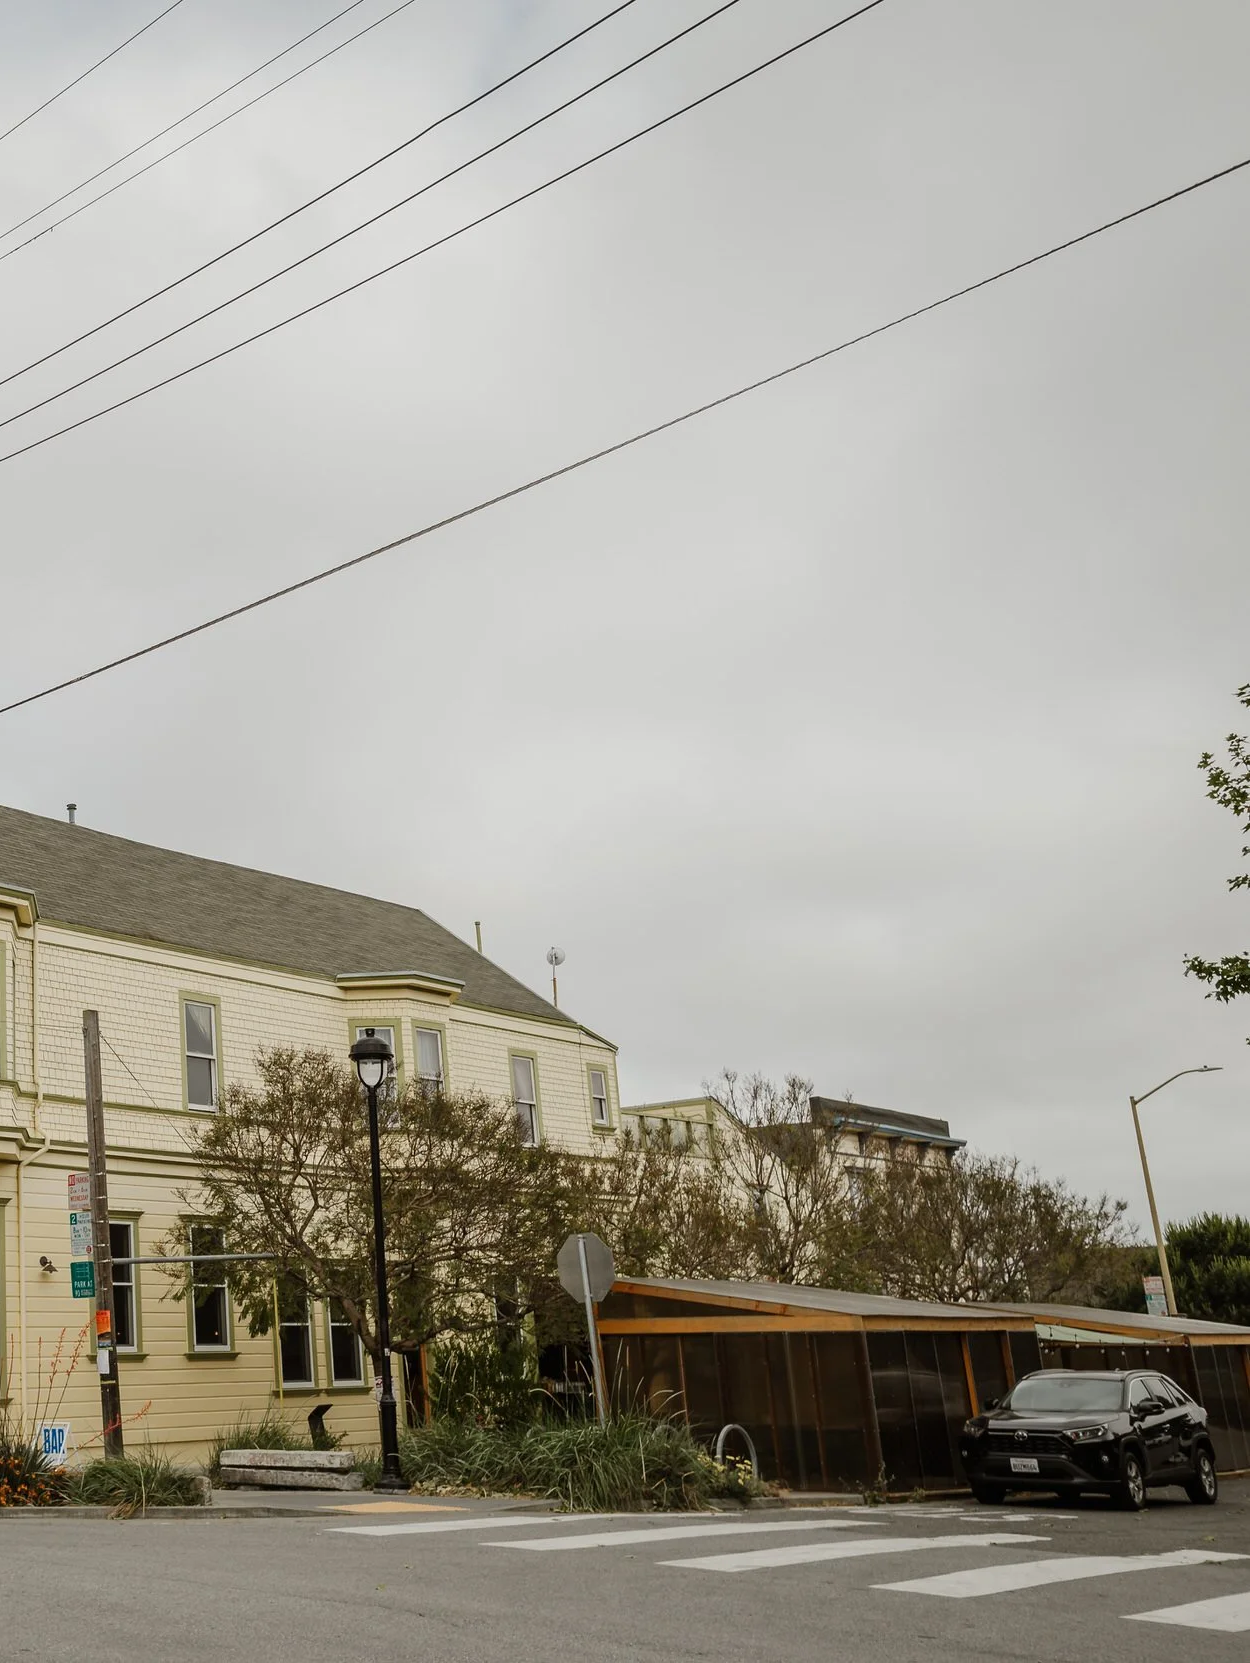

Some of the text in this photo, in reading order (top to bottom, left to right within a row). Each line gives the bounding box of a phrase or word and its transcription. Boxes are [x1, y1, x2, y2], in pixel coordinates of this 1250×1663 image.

[74, 1279, 93, 1289] PARK AT
[43, 1428, 65, 1454] BAR
